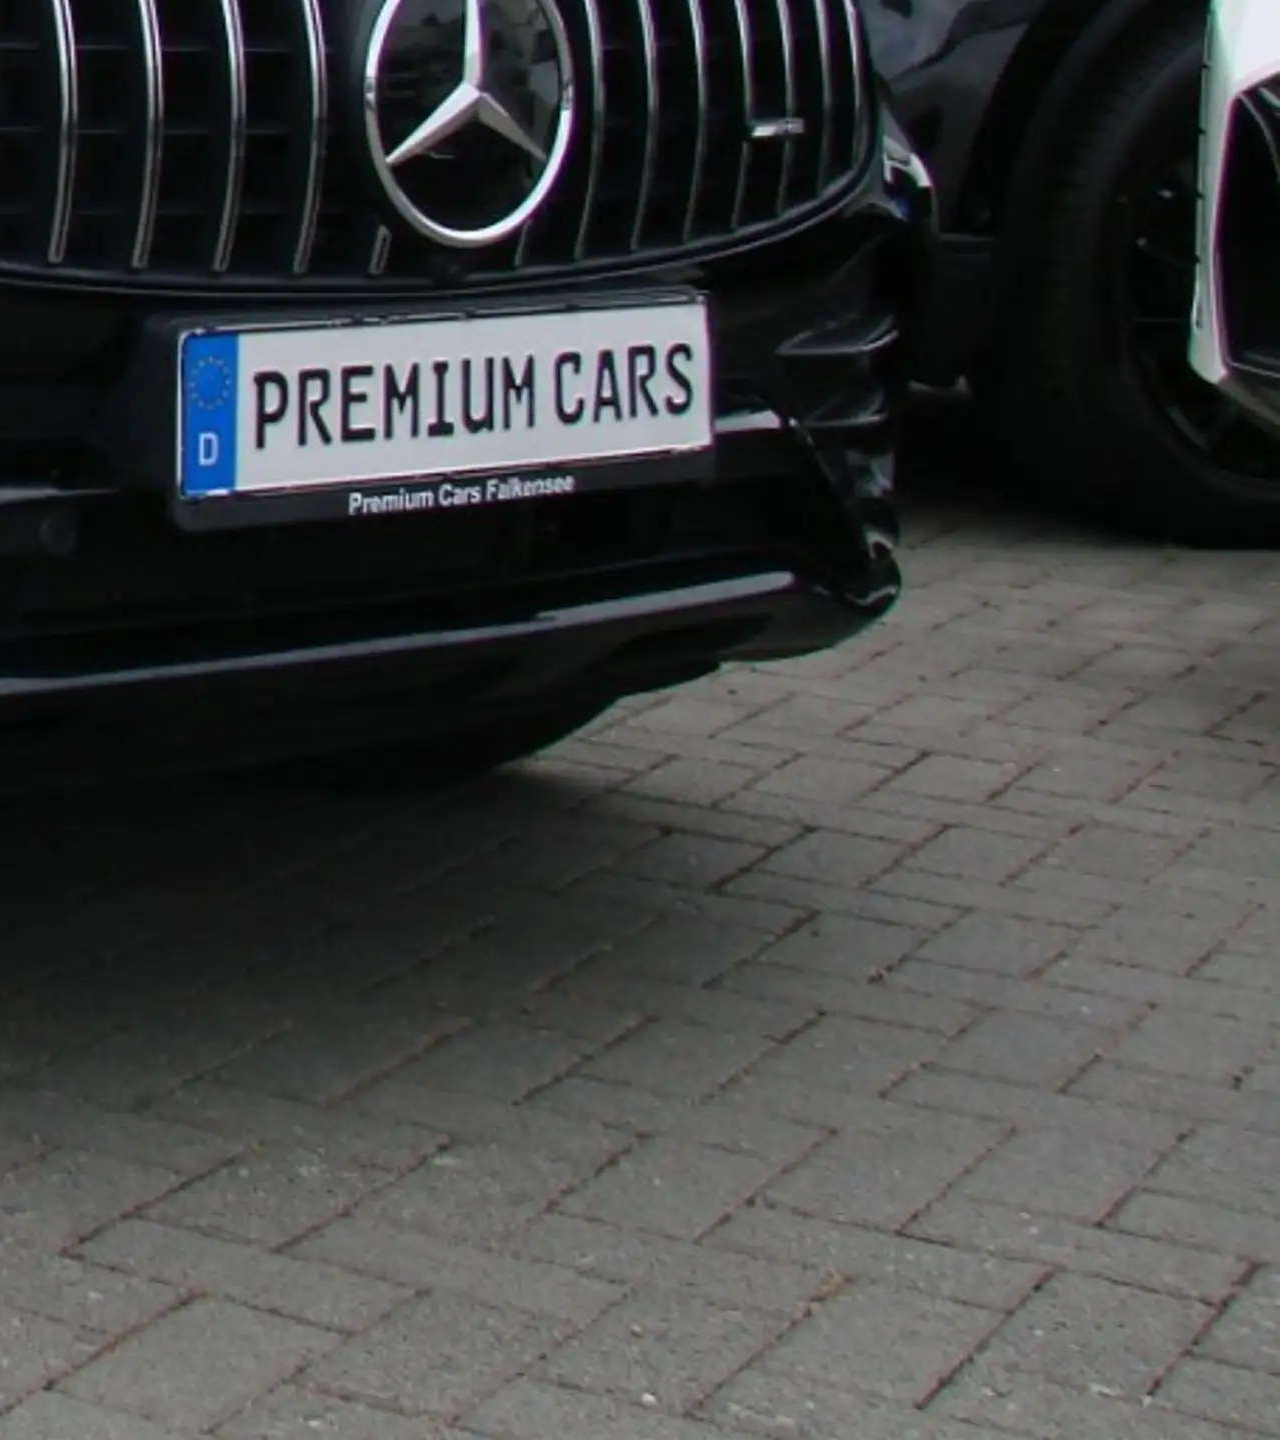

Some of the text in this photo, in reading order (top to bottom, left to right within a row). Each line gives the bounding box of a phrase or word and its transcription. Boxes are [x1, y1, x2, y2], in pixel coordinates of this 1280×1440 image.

[252, 342, 693, 450] PREMIUM CARS
[197, 431, 220, 467] D
[348, 474, 575, 516] Premium Cars Falkensee
